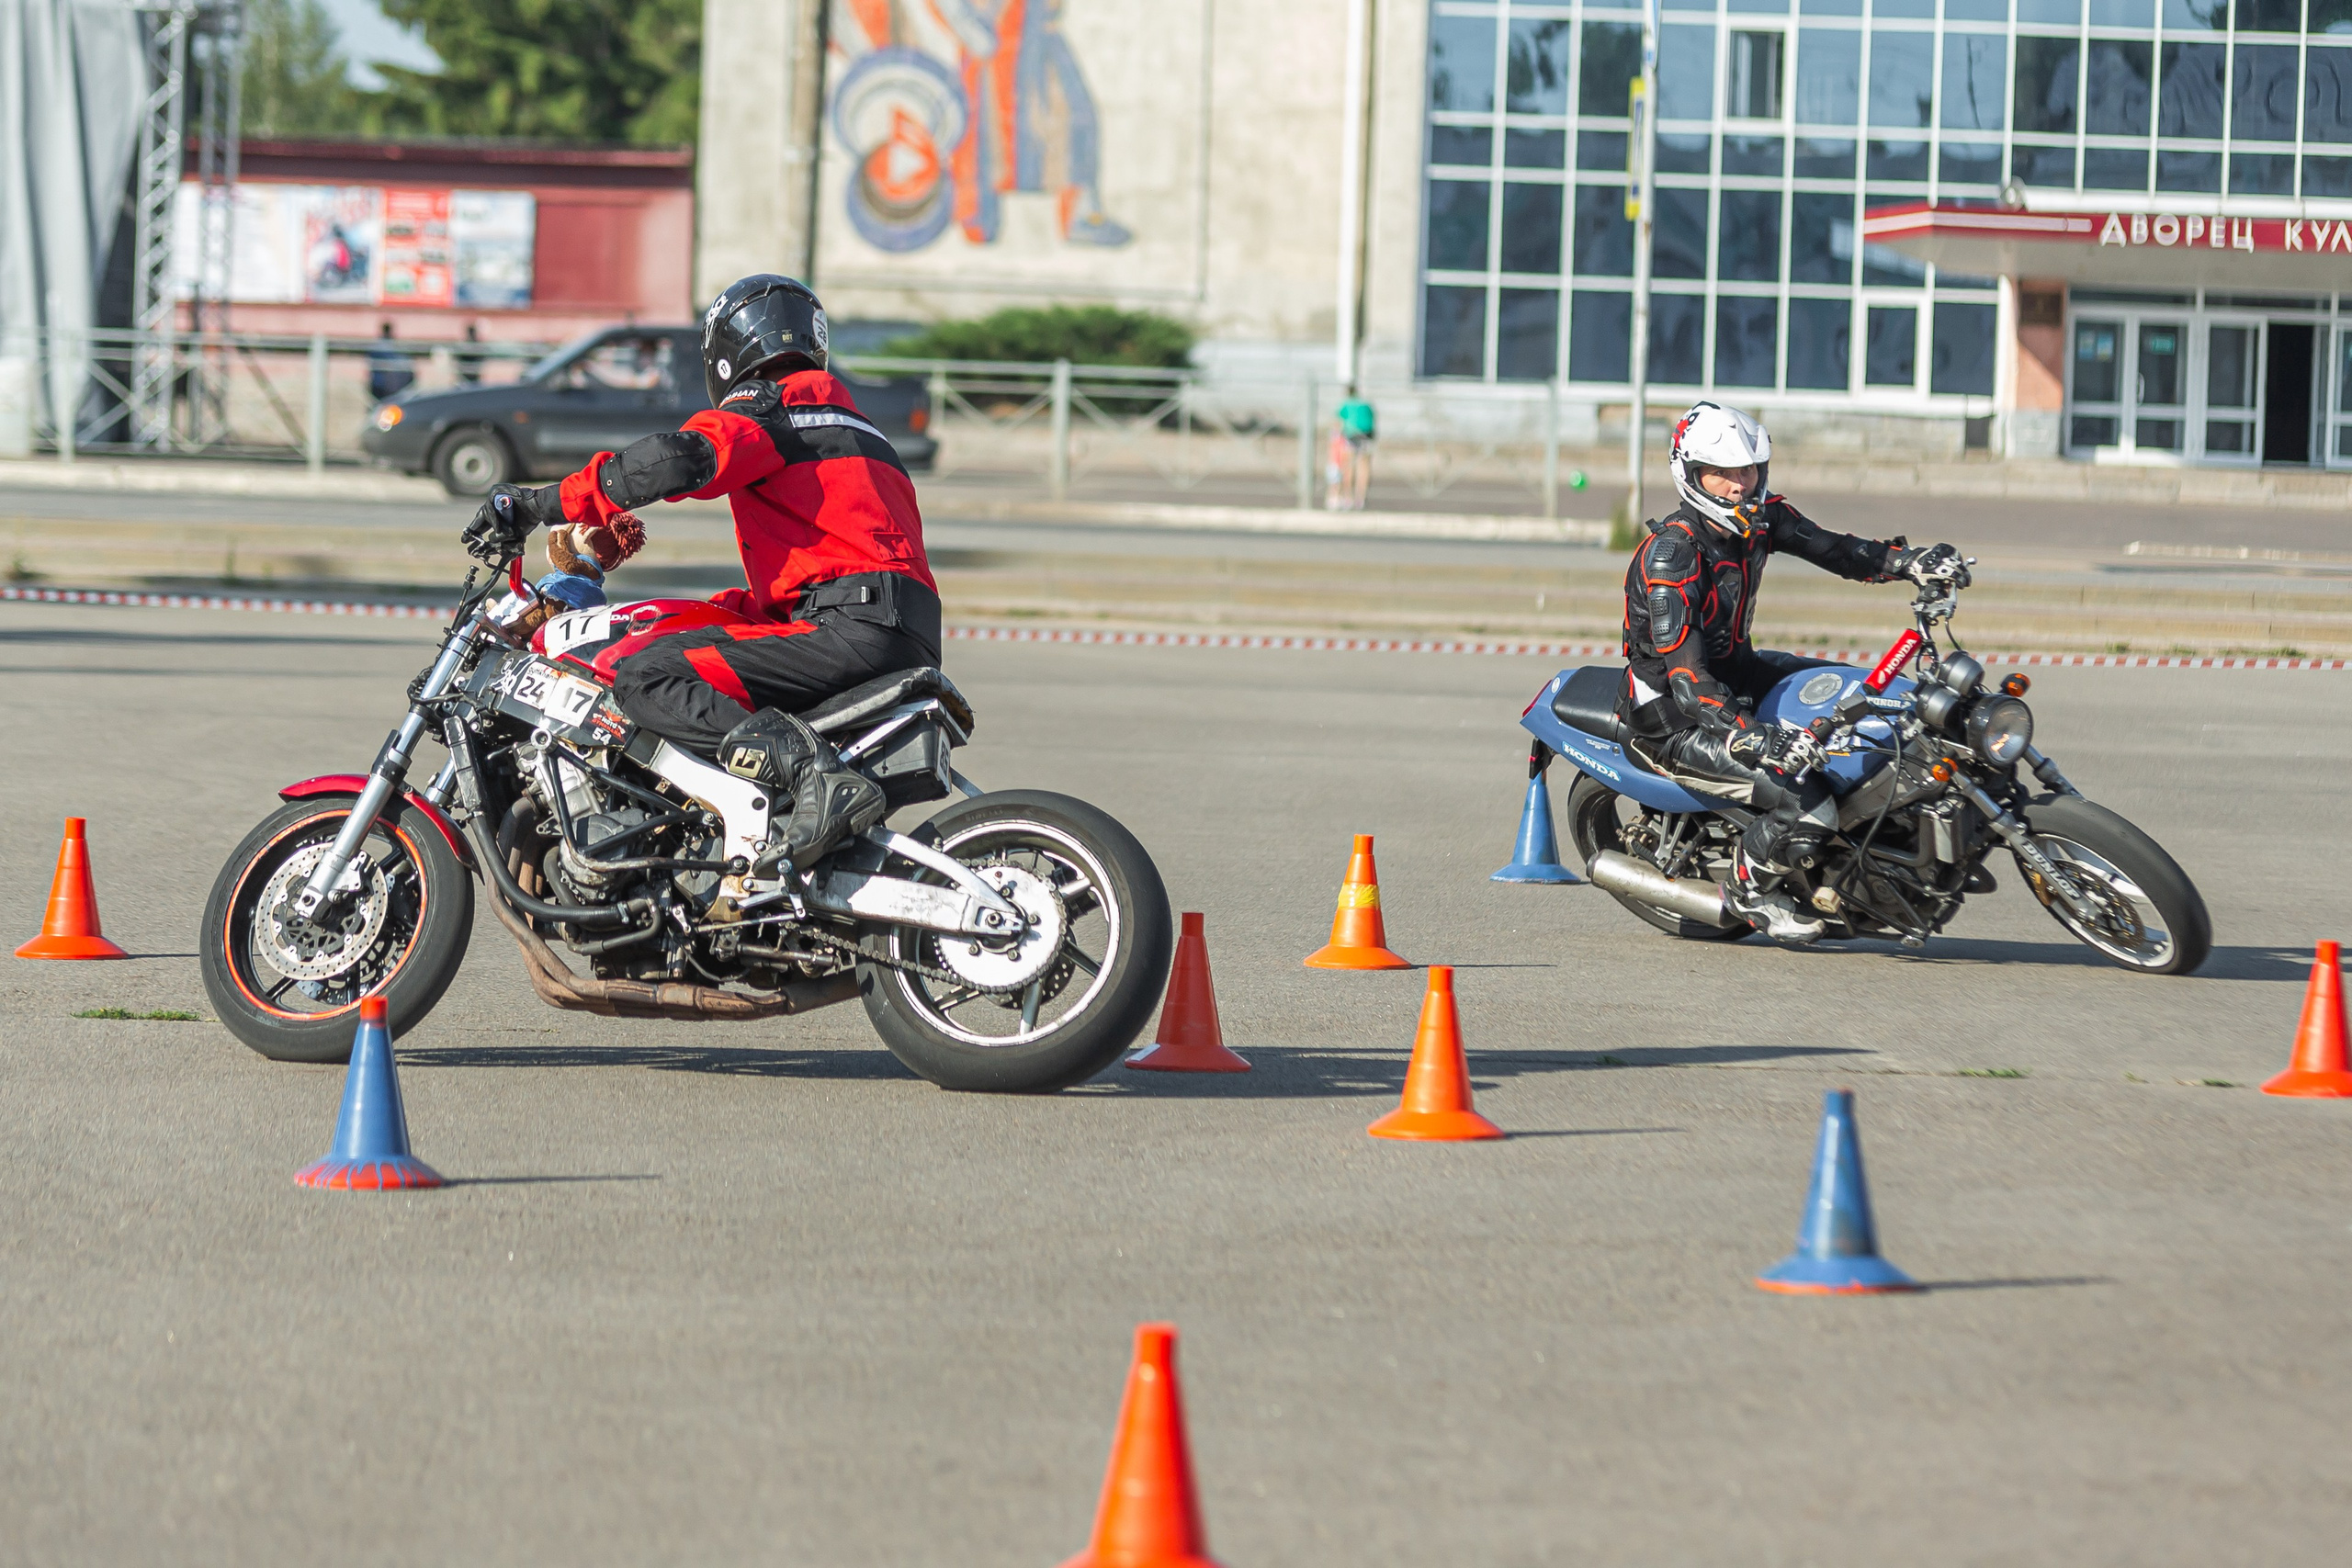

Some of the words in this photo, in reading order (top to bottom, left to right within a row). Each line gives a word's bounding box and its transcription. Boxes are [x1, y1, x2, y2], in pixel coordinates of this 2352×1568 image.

[2098, 210, 2255, 254] ДВОРЕЦ
[2284, 218, 2352, 253] КУЛ
[559, 614, 600, 641] 17
[1884, 638, 1917, 676] HONDA
[517, 675, 546, 704] 24
[561, 686, 594, 714] 17
[592, 727, 613, 746] 54
[1564, 743, 1620, 782] HONDA
[2022, 841, 2081, 898] DUNLOP
